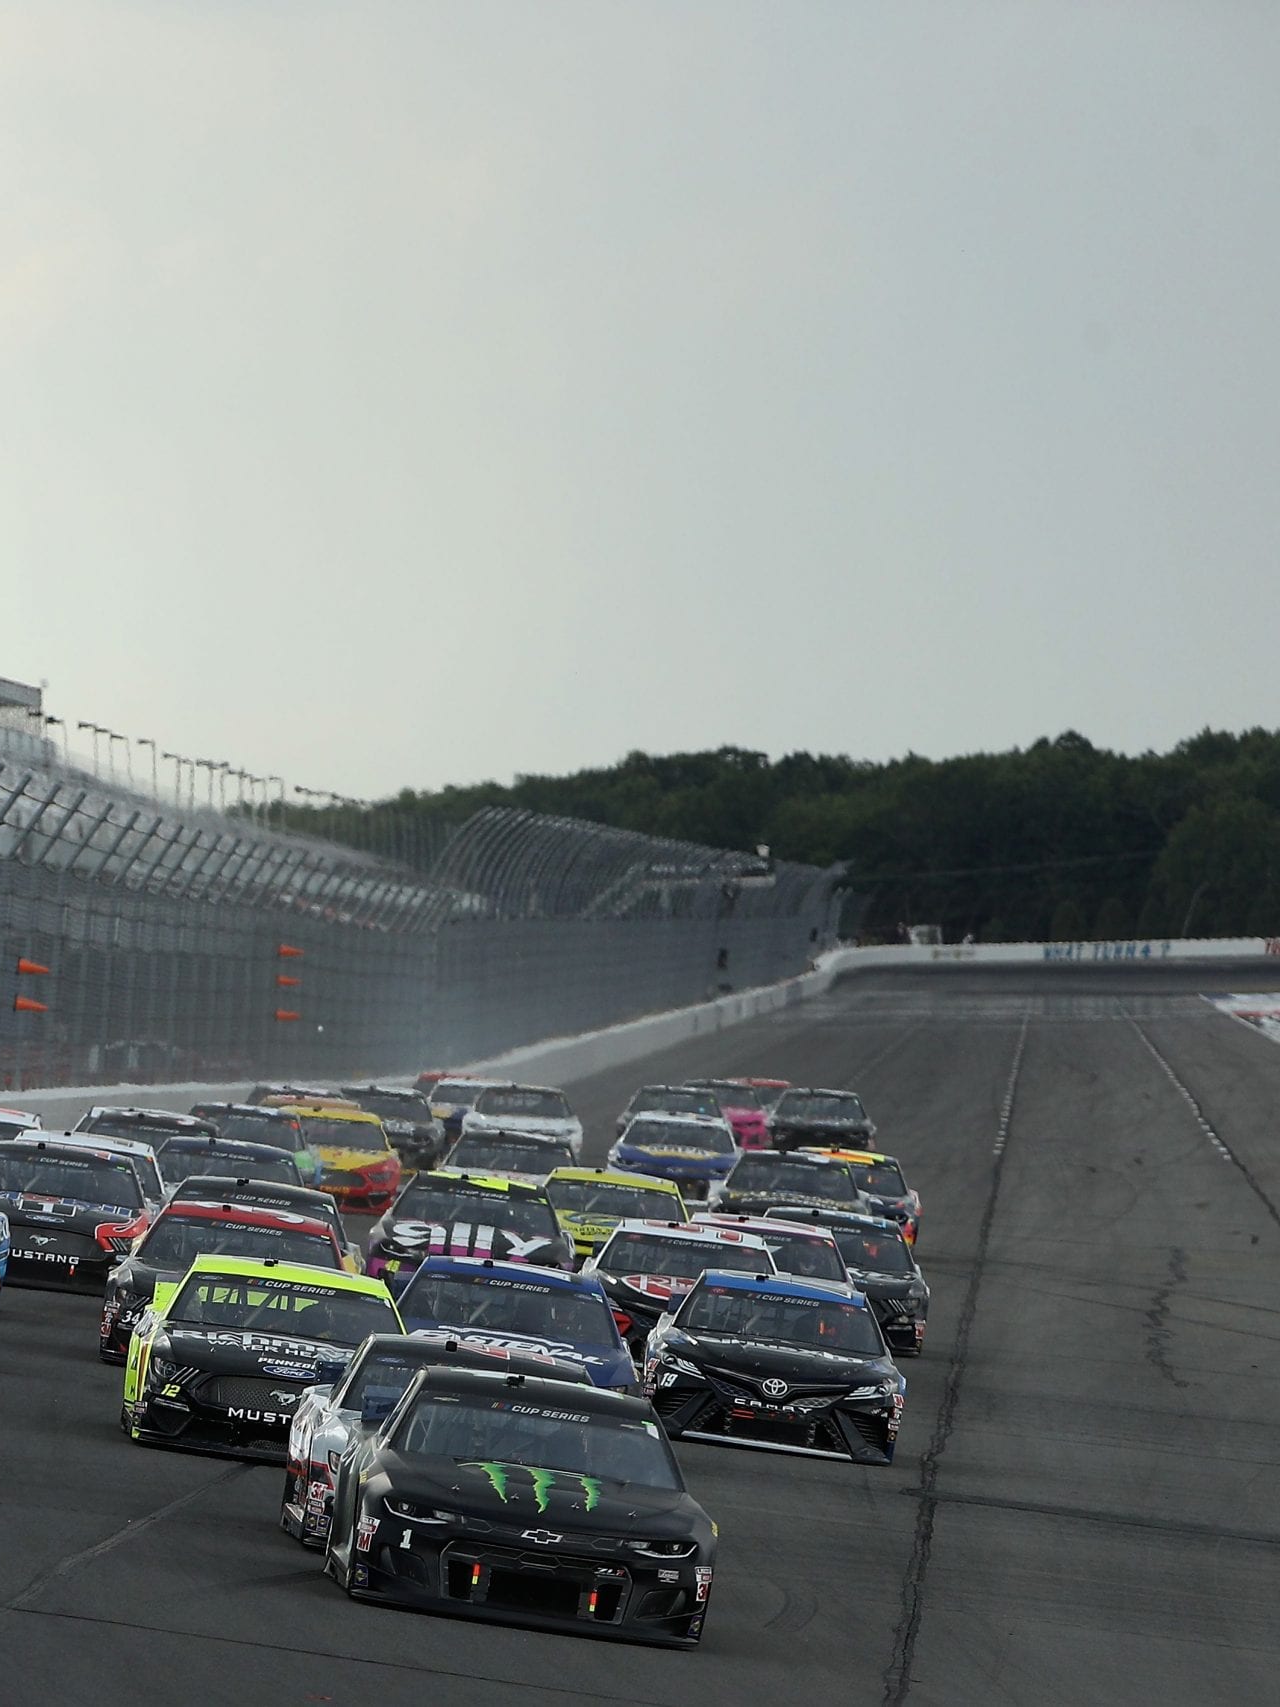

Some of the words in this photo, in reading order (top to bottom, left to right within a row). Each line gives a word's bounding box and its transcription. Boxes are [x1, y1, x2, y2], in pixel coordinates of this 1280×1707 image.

[257, 1197, 291, 1206] SERIES
[225, 1222, 246, 1230] CUP
[247, 1226, 282, 1236] SERIES
[392, 1222, 553, 1262] ally
[11, 1248, 80, 1264] USTANG
[265, 1280, 290, 1289] CUP
[292, 1283, 336, 1296] SERIES
[512, 1283, 551, 1293] SERIES
[784, 1297, 819, 1307] SERIES
[121, 1310, 140, 1324] 34
[267, 1366, 310, 1378] Ford
[660, 1372, 678, 1387] 19
[161, 1383, 180, 1397] 12
[228, 1406, 292, 1425] MUST
[512, 1404, 540, 1415] CUP
[541, 1409, 590, 1423] SERIES
[399, 1529, 412, 1549] 1
